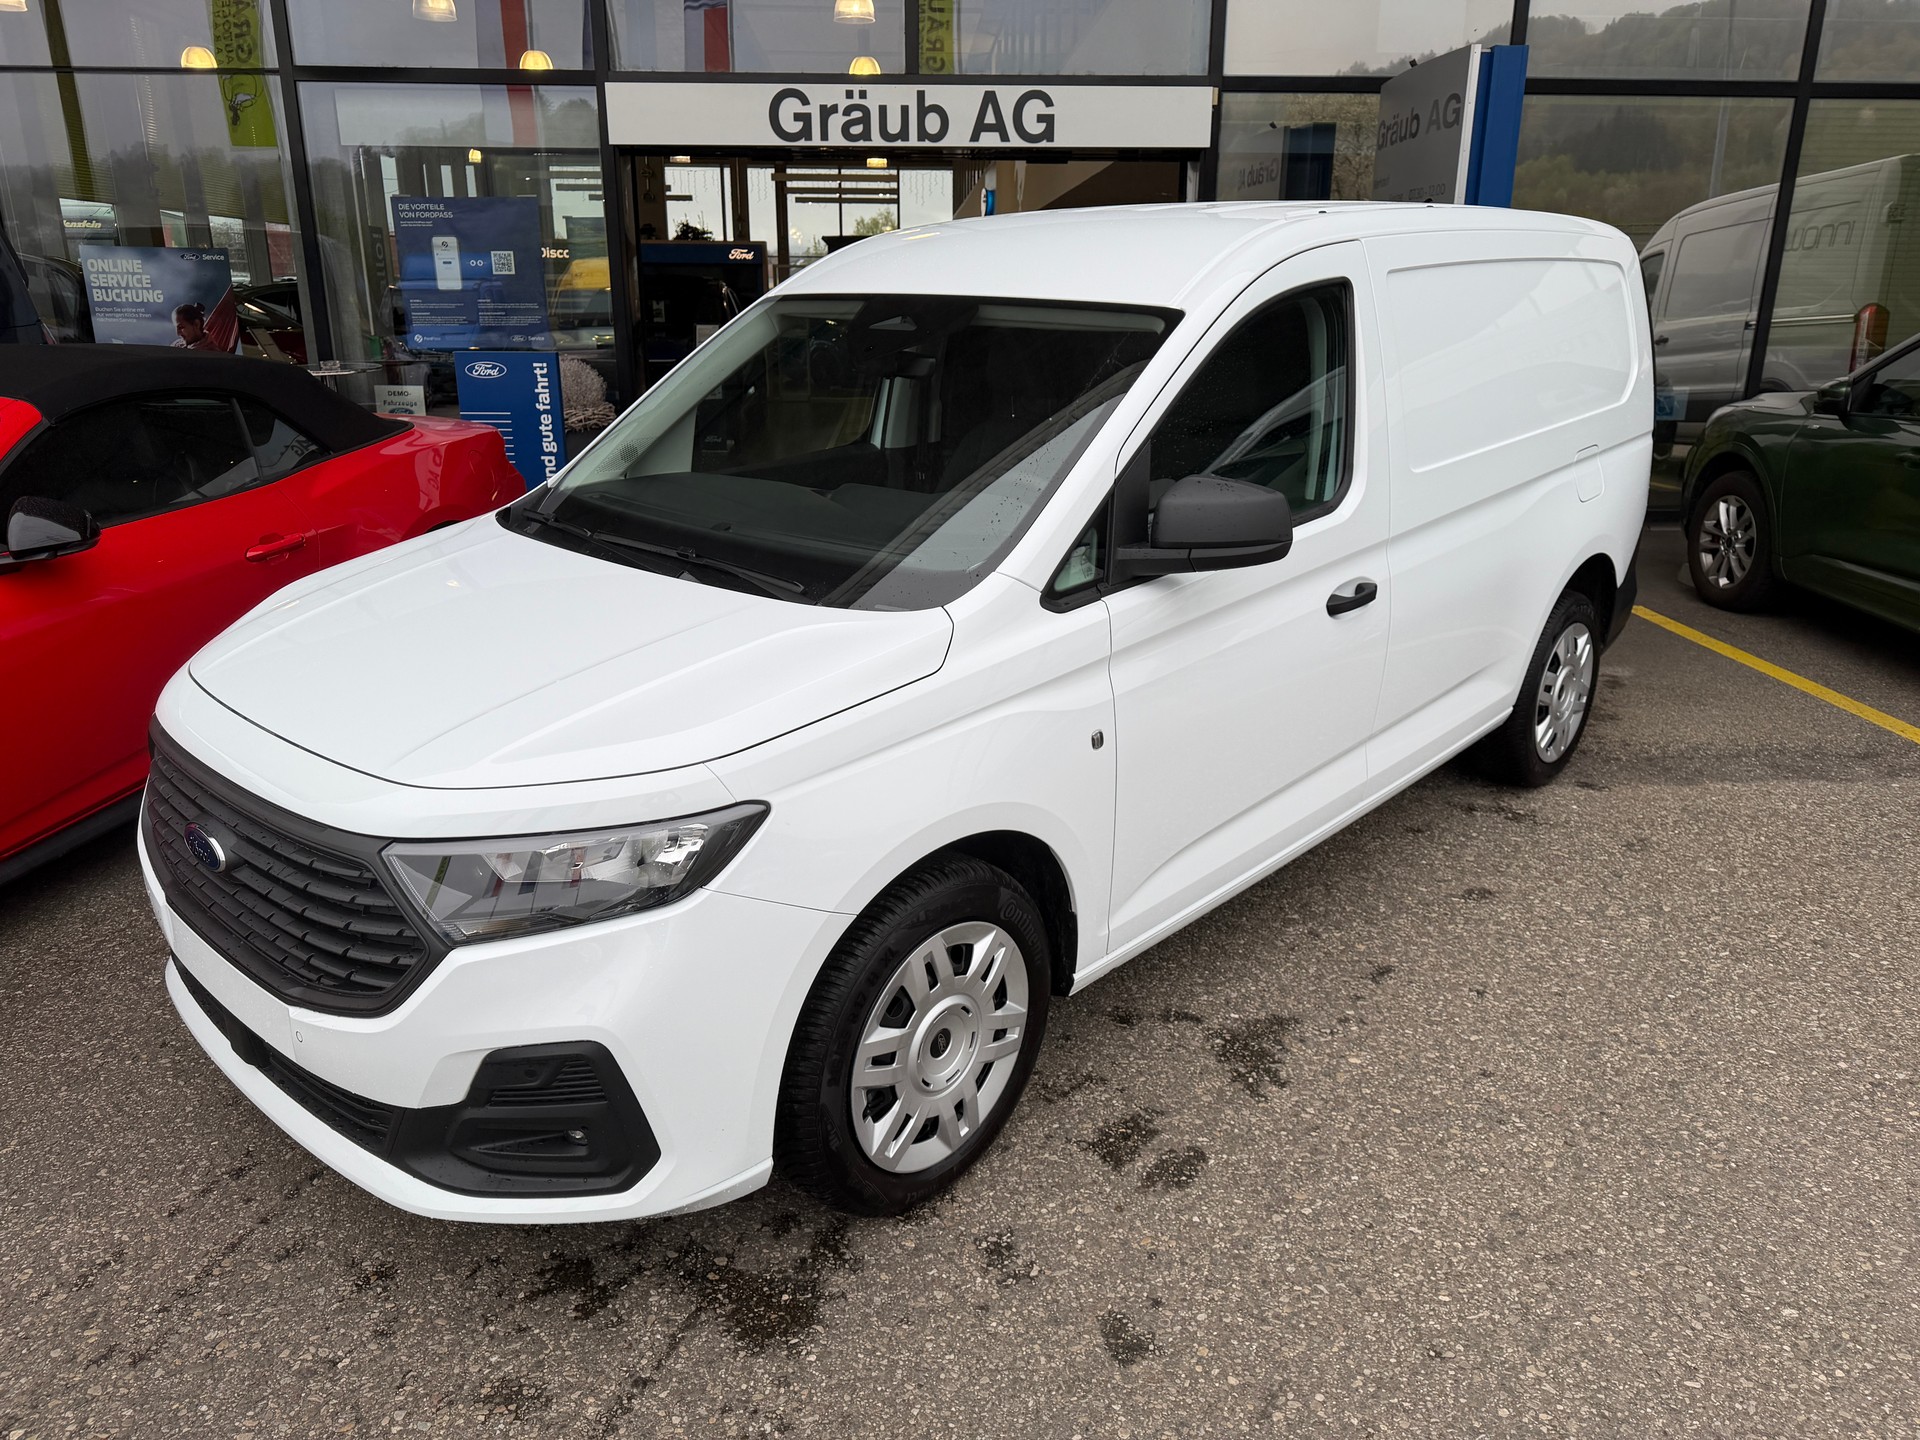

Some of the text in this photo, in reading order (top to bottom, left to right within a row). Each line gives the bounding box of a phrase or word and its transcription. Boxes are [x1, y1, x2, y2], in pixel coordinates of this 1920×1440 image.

[768, 87, 1056, 144] Gräub AG
[1377, 92, 1462, 151] Gräub AG
[410, 203, 445, 211] VORTEILE
[415, 211, 454, 219] FORDPASS
[202, 253, 225, 261] Service
[728, 248, 755, 260] Ford
[87, 258, 143, 273] ONLINE
[90, 274, 152, 288] SERVICE
[93, 288, 164, 303] BUCHUNG
[472, 363, 500, 377] Ford
[532, 361, 552, 412] fahrt!
[383, 399, 418, 408] Fahrzeuge
[538, 413, 559, 454] gute
